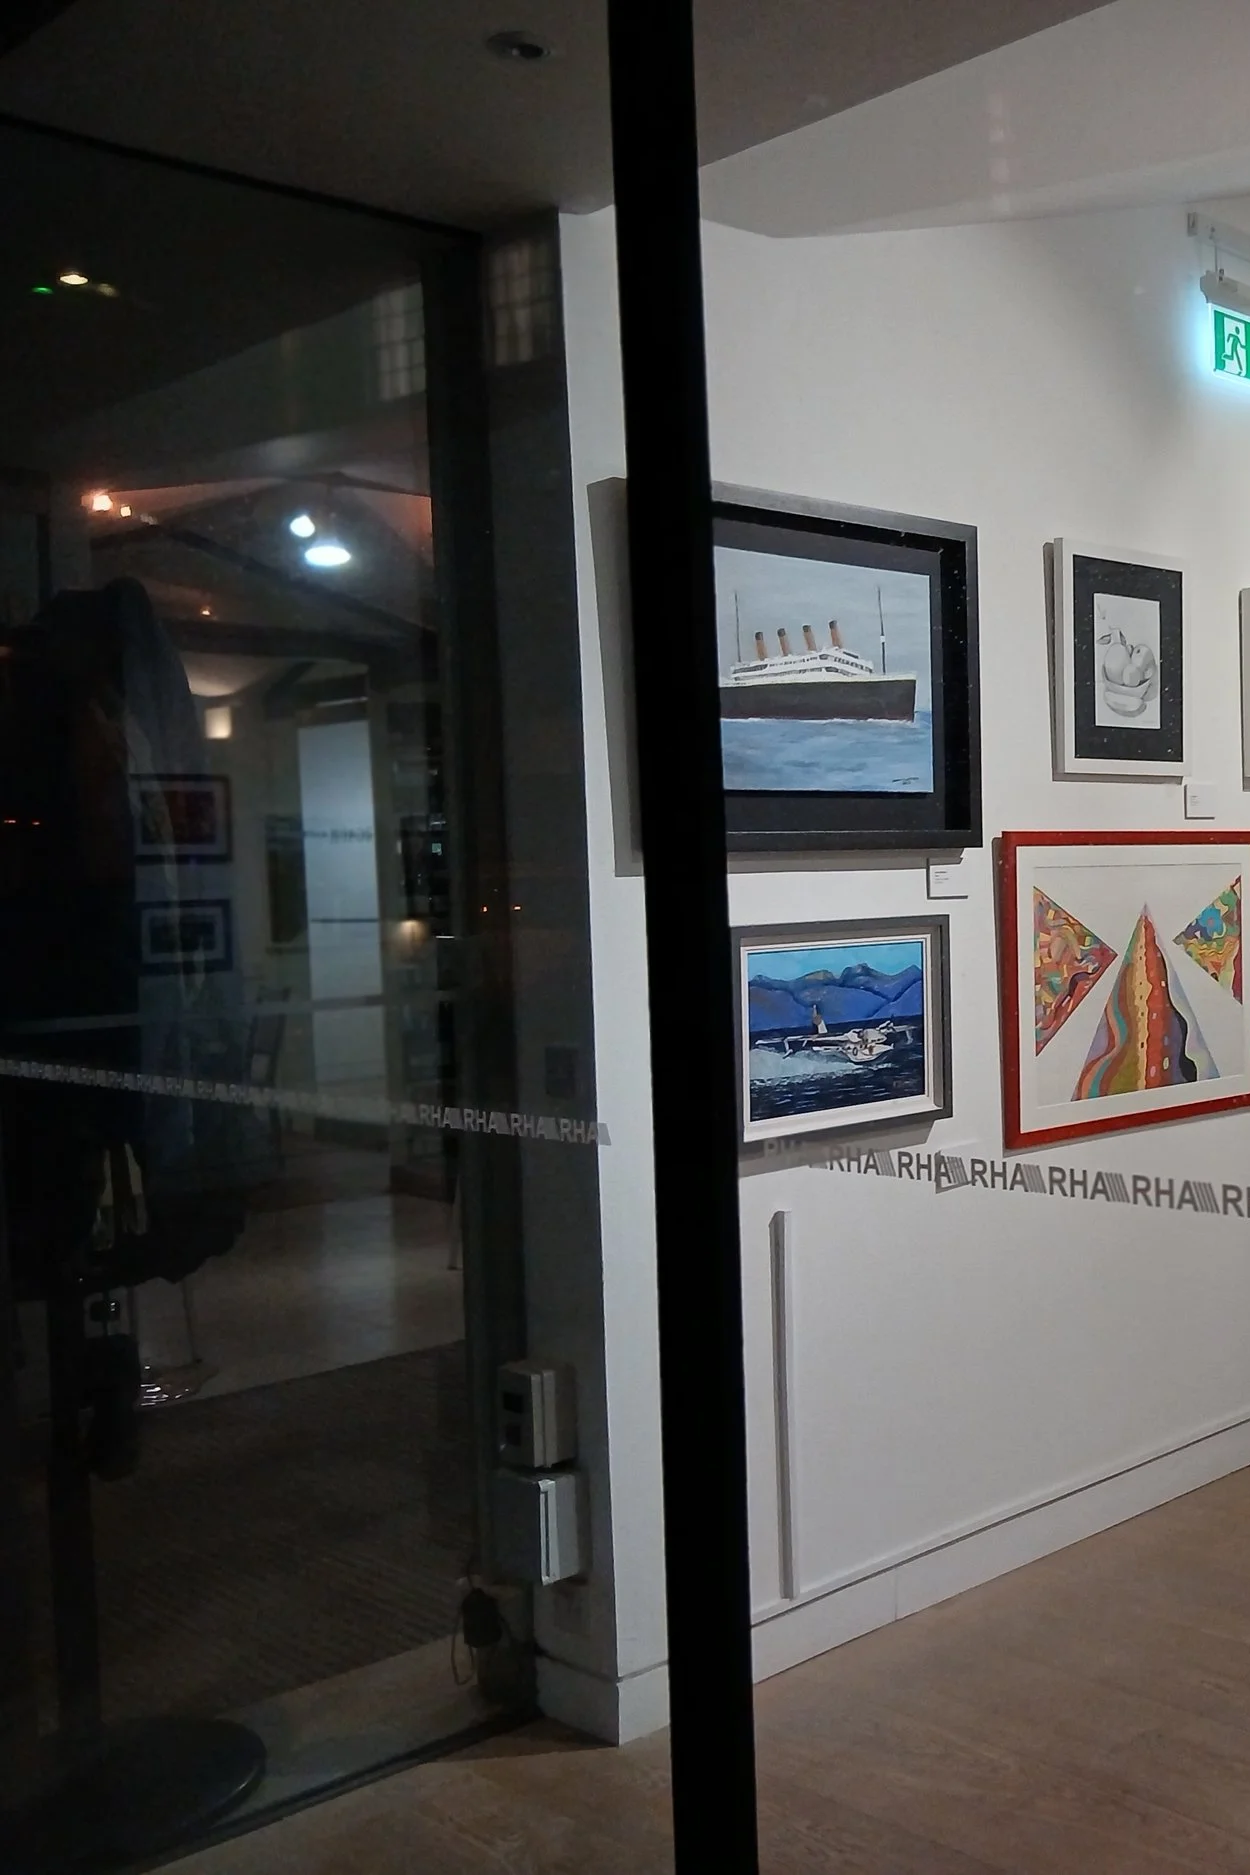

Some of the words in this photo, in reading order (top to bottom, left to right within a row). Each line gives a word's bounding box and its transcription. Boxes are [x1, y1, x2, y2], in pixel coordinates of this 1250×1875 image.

[419, 1103, 451, 1129] RHA
[463, 1108, 498, 1134] RHA
[510, 1113, 547, 1139] RHA
[559, 1118, 599, 1144] RHA
[829, 1145, 880, 1176] RHA
[898, 1151, 952, 1185] RHA
[970, 1158, 1027, 1193] RHA
[1048, 1166, 1110, 1201] RHA
[1132, 1174, 1199, 1213] RHA
